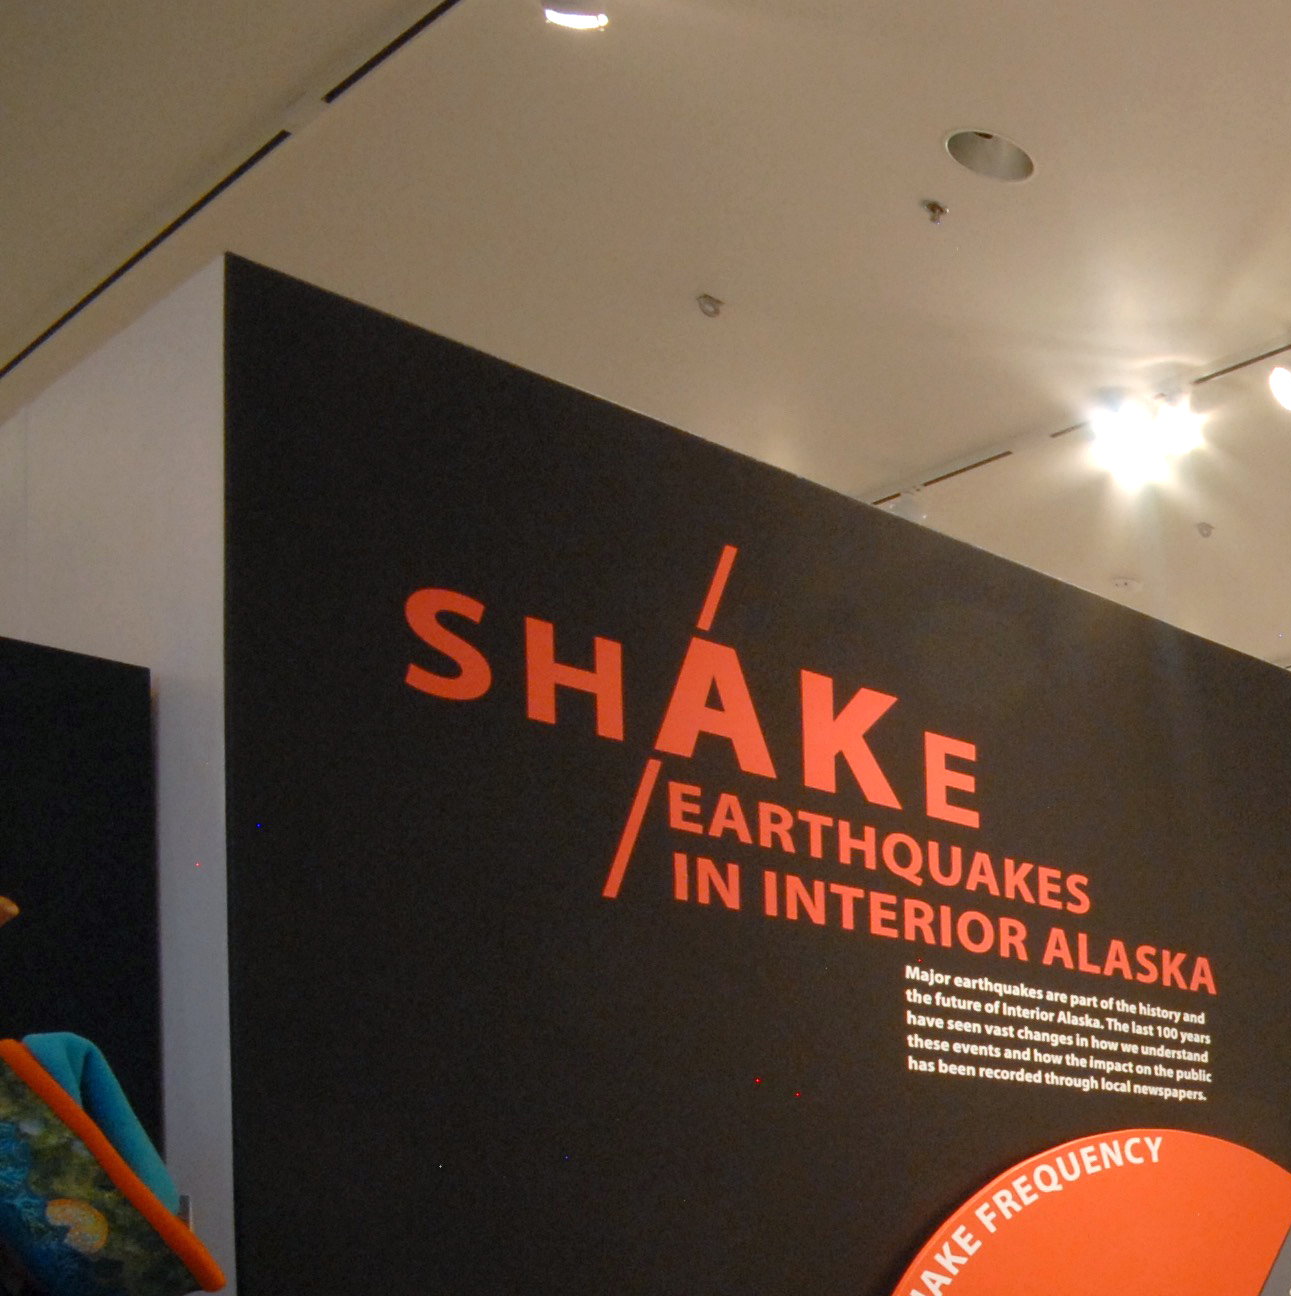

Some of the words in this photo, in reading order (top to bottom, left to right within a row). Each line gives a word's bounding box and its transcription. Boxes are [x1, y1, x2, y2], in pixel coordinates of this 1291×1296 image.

[404, 587, 981, 829] SHAKE
[668, 780, 1092, 916] EARTHQUAKES
[673, 852, 740, 911] IN
[763, 871, 1028, 963] INTERIOR
[1043, 930, 1218, 996] ALASKA
[905, 965, 951, 986] Major
[954, 977, 1043, 999] earthquakes
[1046, 991, 1067, 1003] are
[1070, 995, 1098, 1008] part
[1100, 998, 1114, 1010] of
[1116, 1000, 1136, 1014] the
[1139, 1002, 1181, 1023] history
[1183, 1012, 1205, 1024] and
[906, 989, 932, 1004] the
[935, 992, 982, 1012] future
[984, 1001, 1000, 1014] of
[1003, 1002, 1055, 1022] Interior
[1057, 1011, 1104, 1029] Alaska.
[1106, 1018, 1129, 1032] The
[1132, 1021, 1153, 1036] last
[1157, 1026, 1178, 1039] 100
[1180, 1032, 1211, 1044] years
[907, 1010, 944, 1029] have
[947, 1020, 981, 1033] seen
[984, 1025, 1014, 1038] vast
[1017, 1026, 1073, 1047] changes
[1076, 1033, 1088, 1047] in
[1091, 1035, 1118, 1051] how
[1121, 1043, 1139, 1054] we
[1141, 1045, 1208, 1063] understand
[907, 1034, 949, 1051] these
[953, 1042, 1001, 1057] events
[1004, 1048, 1031, 1061] and
[1034, 1049, 1063, 1064] how
[1065, 1053, 1087, 1068] the
[1089, 1056, 1133, 1073] impact
[1136, 1065, 1151, 1075] on
[1154, 1064, 1174, 1078] the
[1176, 1068, 1211, 1082] public
[908, 1055, 935, 1072] has
[938, 1059, 976, 1076] been
[979, 1067, 1042, 1083] recorded
[1044, 1072, 1098, 1091] through
[1101, 1077, 1131, 1092] local
[1133, 1084, 1206, 1101] newspapers.
[975, 1136, 1165, 1234] FREQUENCY
